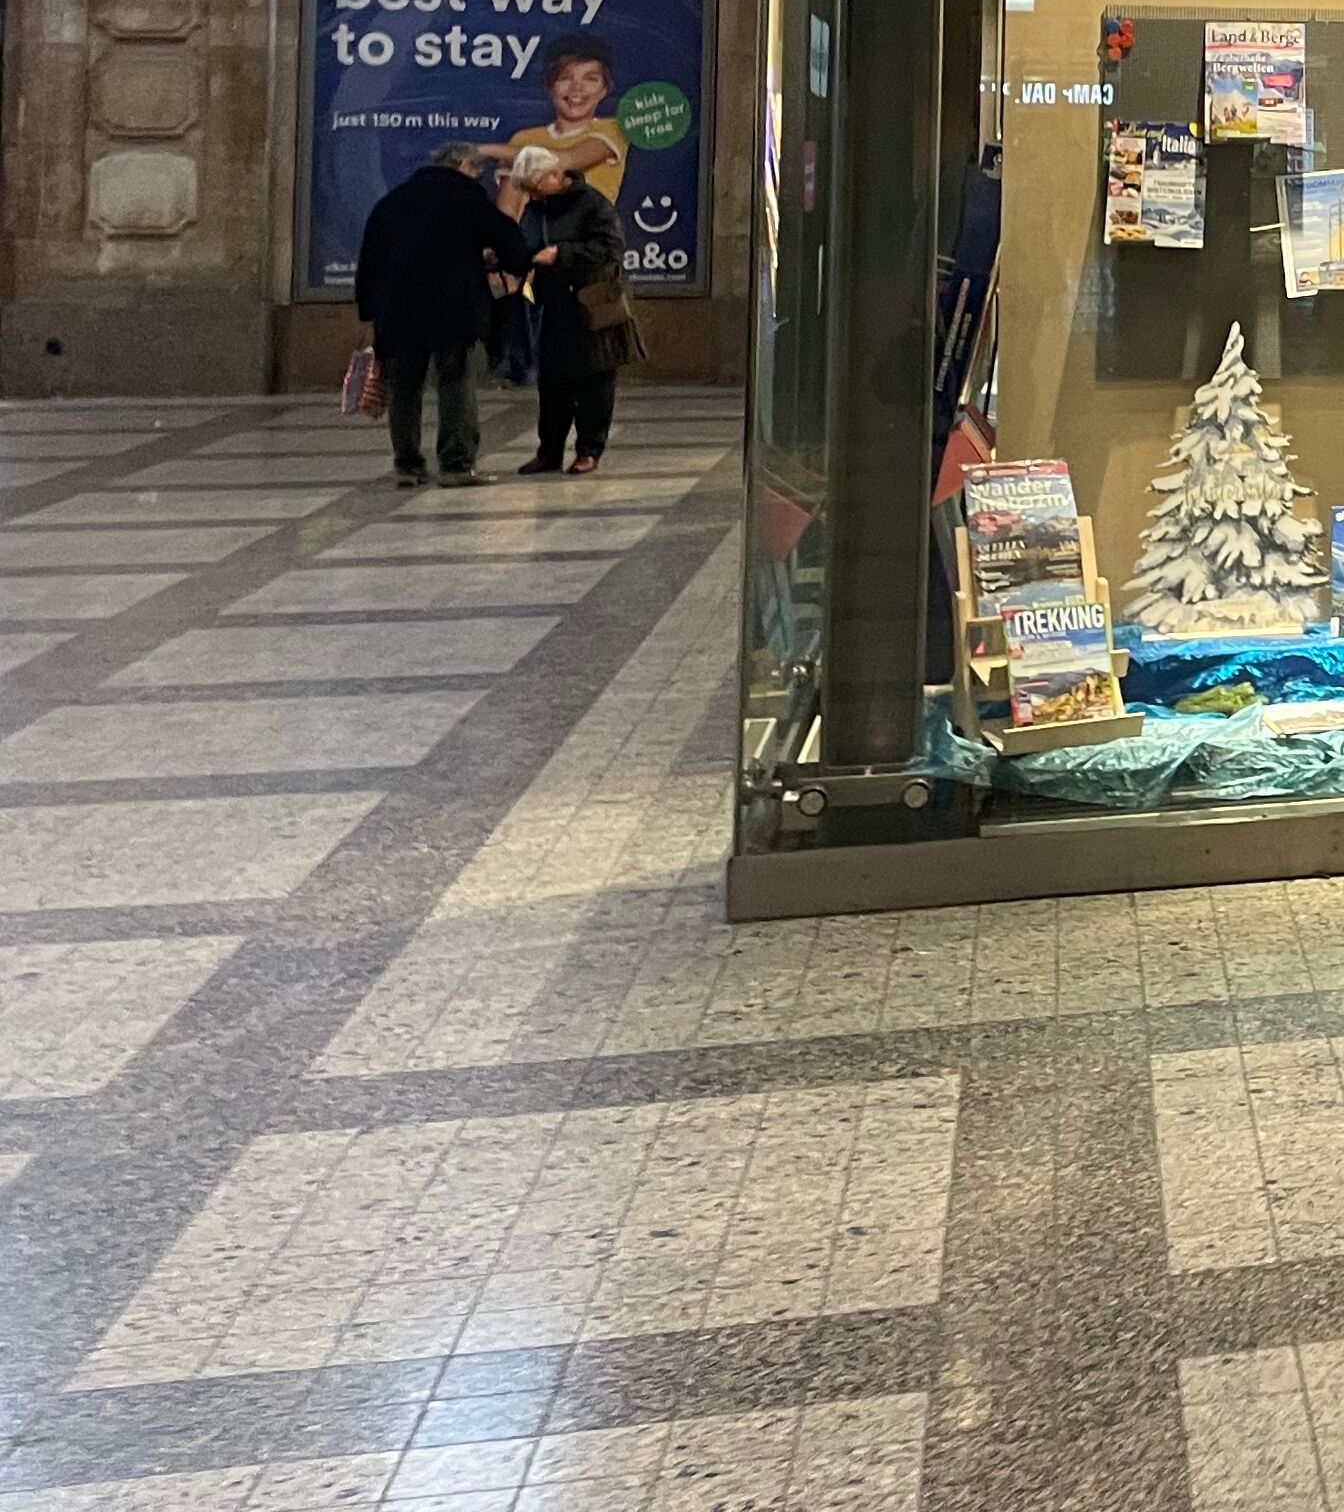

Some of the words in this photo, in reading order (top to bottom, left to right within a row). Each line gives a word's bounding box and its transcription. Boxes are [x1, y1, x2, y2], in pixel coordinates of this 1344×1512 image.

[1211, 30, 1247, 43] Land
[1261, 31, 1300, 47] Berge
[332, 24, 394, 66] to
[415, 25, 541, 79] stay
[1213, 63, 1275, 75] Bergwelten
[332, 111, 366, 130] just
[374, 113, 402, 127] 150
[405, 115, 422, 128] m
[428, 113, 459, 128] this
[464, 116, 500, 130] way
[624, 111, 662, 130] sleep
[664, 103, 684, 117] for
[645, 123, 672, 138] free
[623, 242, 688, 269] a&o
[1014, 604, 1105, 636] TREKKING
